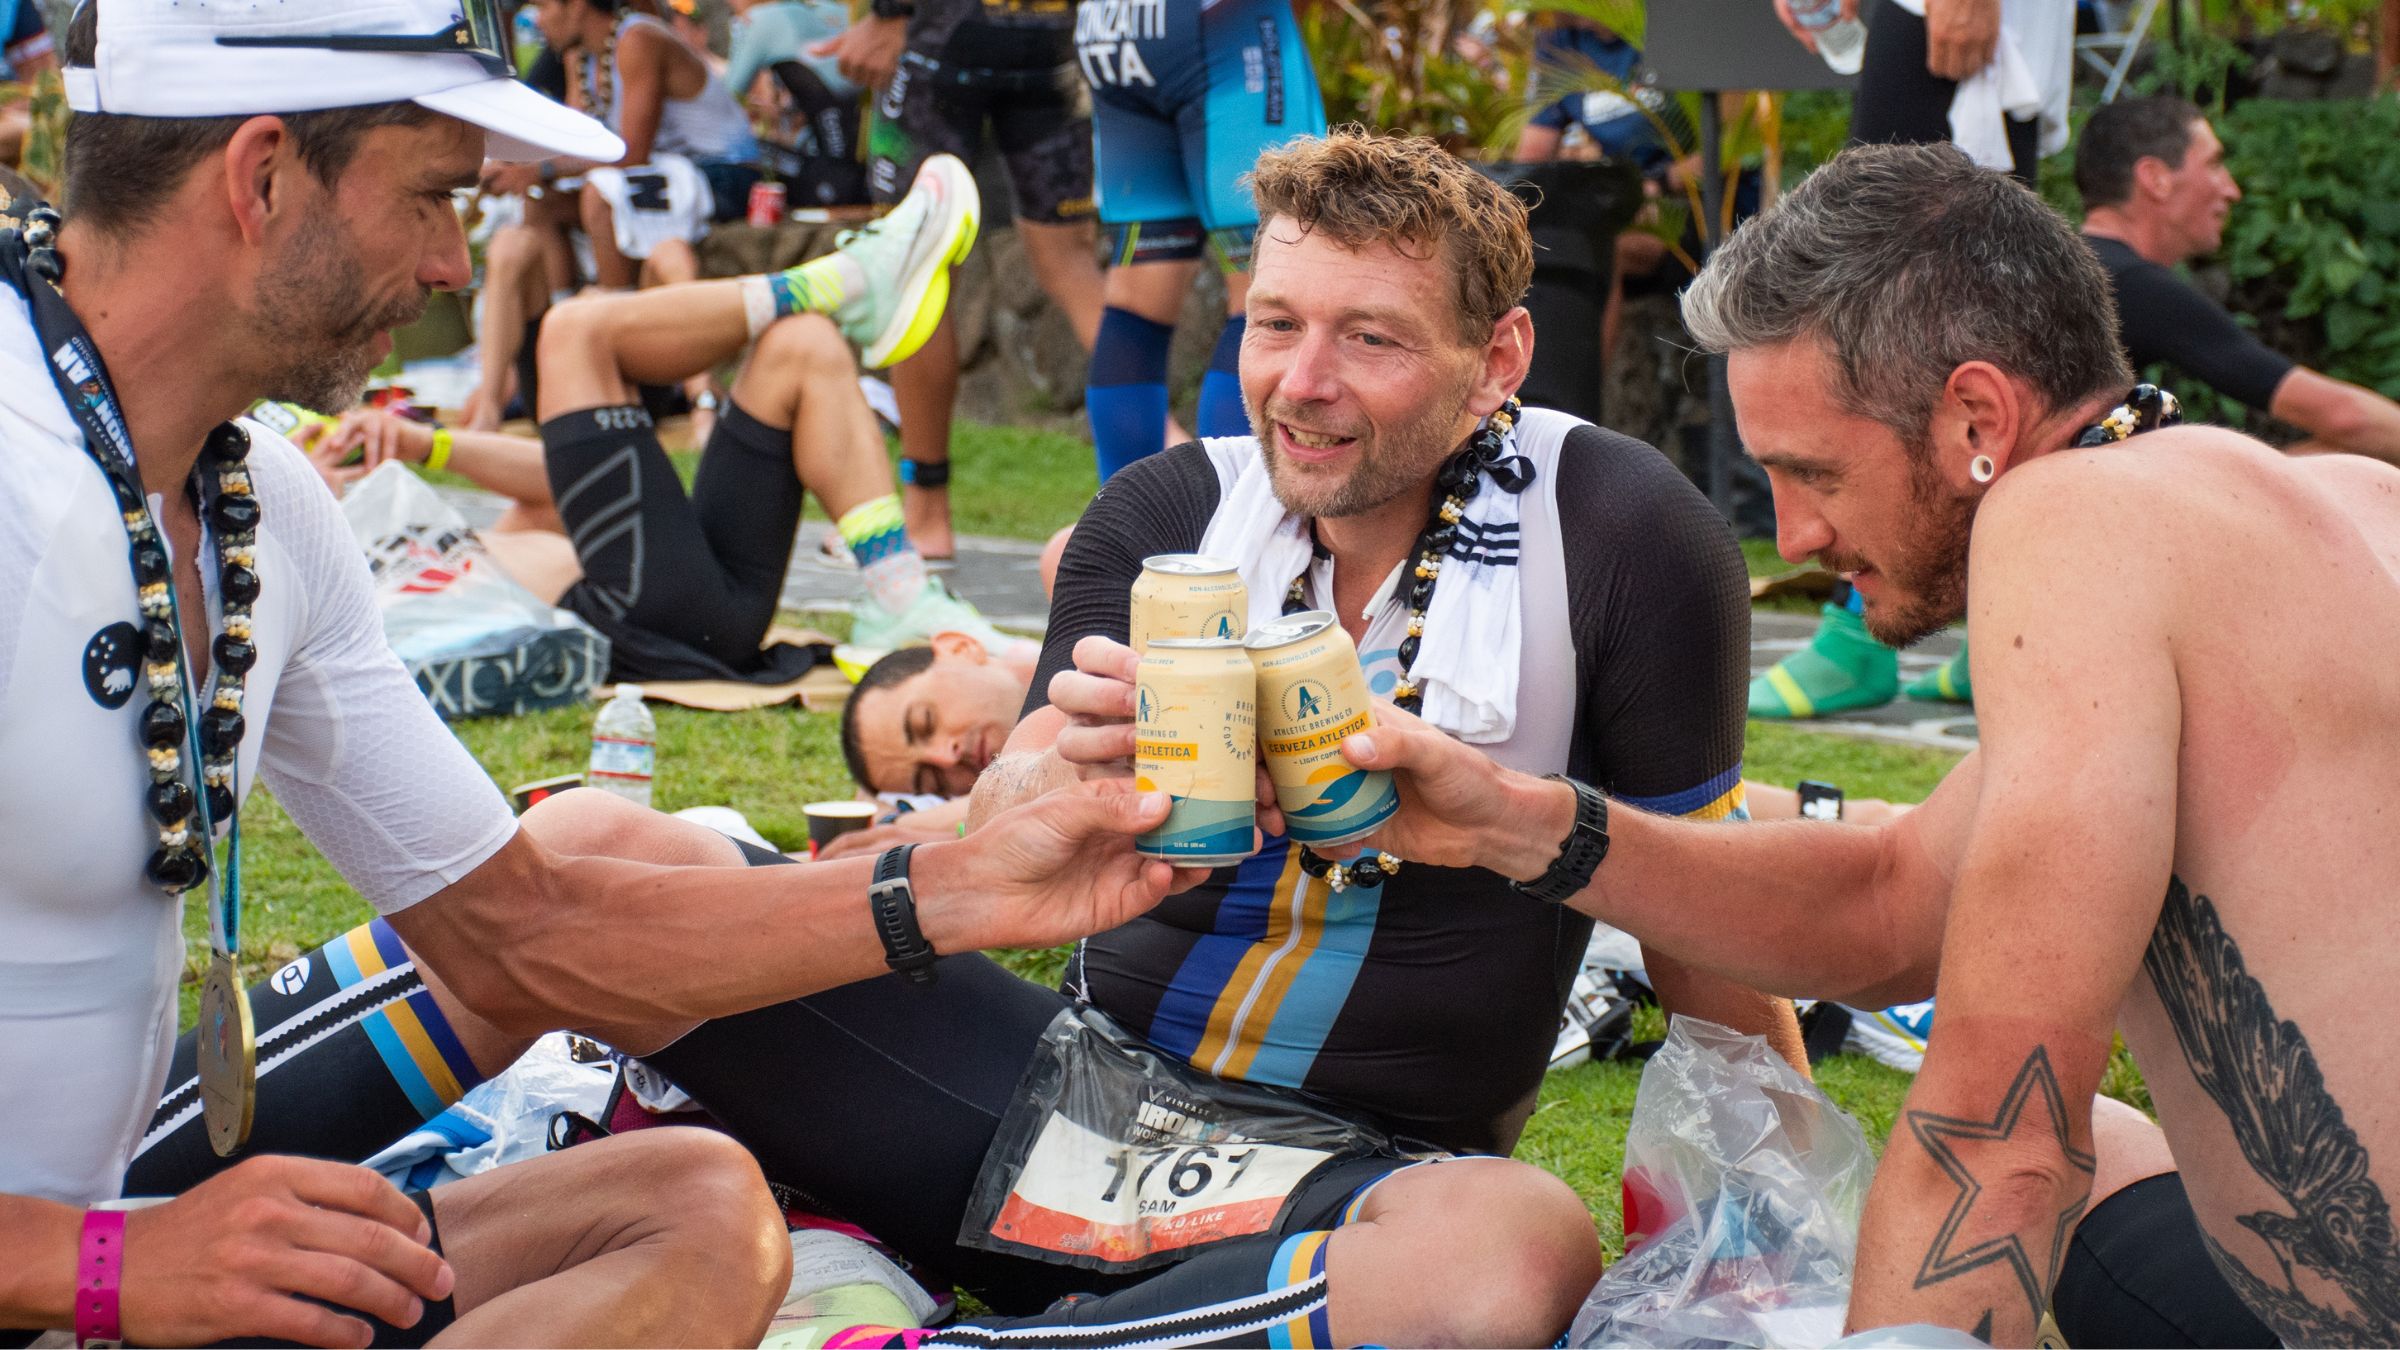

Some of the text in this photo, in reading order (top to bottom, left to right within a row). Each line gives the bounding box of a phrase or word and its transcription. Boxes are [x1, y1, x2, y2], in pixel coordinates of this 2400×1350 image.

[1078, 41, 1157, 90] ITA
[1273, 707, 1352, 737] ATHLETIC BREWING CO
[1268, 717, 1366, 753] CERVEZA ATLETICA
[1143, 746, 1190, 757] ATLETICA
[1299, 749, 1343, 766] LIGHT COPPE
[1165, 1096, 1210, 1117] VINFAST
[1133, 1126, 1171, 1143] WORLD
[1101, 1145, 1260, 1203] 1761
[1138, 1200, 1177, 1215] SAM
[1191, 1211, 1226, 1226] LIKE
